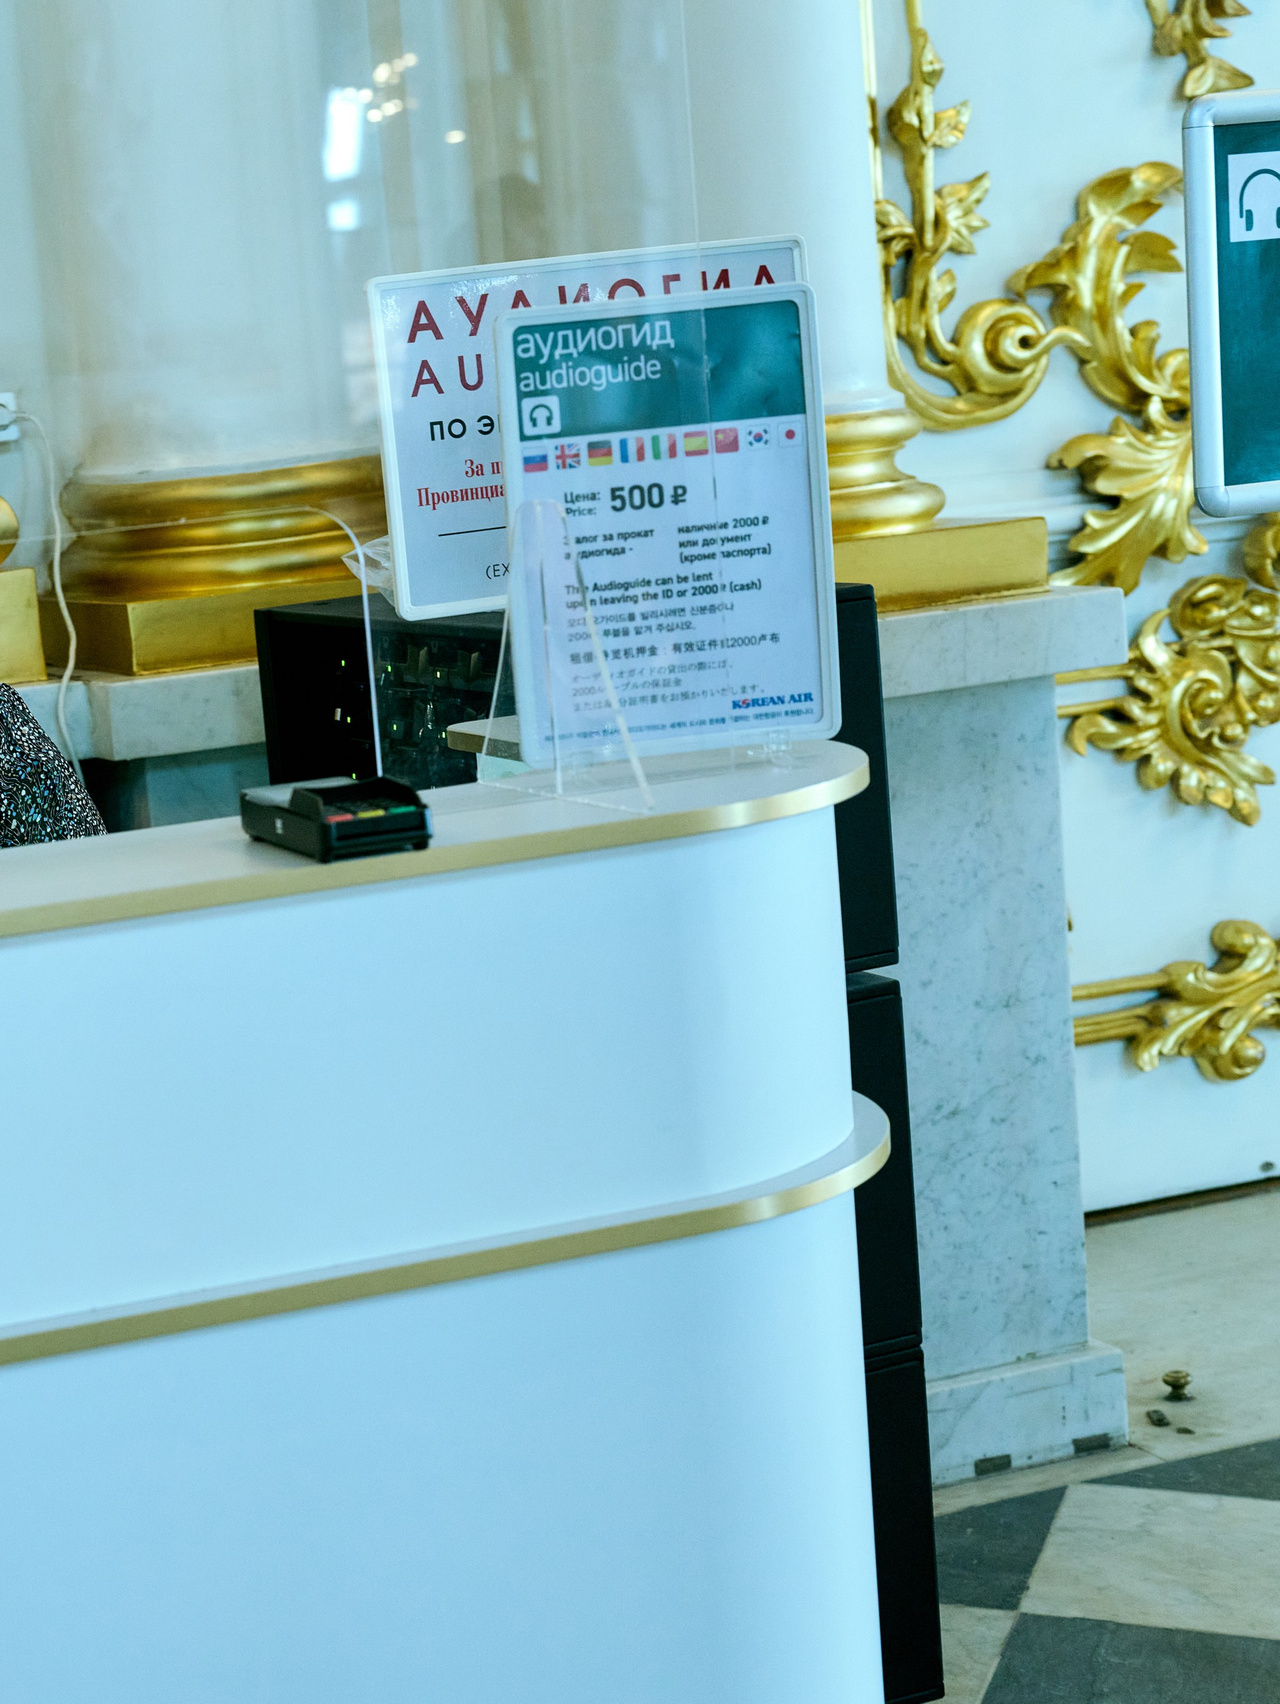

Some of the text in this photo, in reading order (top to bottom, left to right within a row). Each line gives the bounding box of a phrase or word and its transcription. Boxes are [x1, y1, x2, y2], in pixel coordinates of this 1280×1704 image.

[516, 320, 676, 364] аудиогид
[520, 357, 662, 393] audioguide
[476, 414, 500, 436] Э
[464, 458, 485, 478] За
[564, 490, 601, 504] Цена:
[610, 483, 665, 512] 500
[565, 505, 598, 517] Price:
[732, 516, 760, 529] 2000
[617, 528, 655, 542] прокат
[678, 533, 752, 549] или доумент
[564, 546, 626, 561] адиогида
[592, 577, 652, 592] Audioguide
[655, 576, 673, 587] can
[676, 574, 689, 584] be
[692, 571, 713, 582] lent
[599, 594, 639, 606] leaving
[641, 590, 660, 602] the
[662, 588, 674, 600] ID
[676, 590, 688, 598] or
[691, 583, 719, 597] 2000
[729, 578, 762, 594] (cash)
[731, 692, 814, 710] KOREAN AIR
